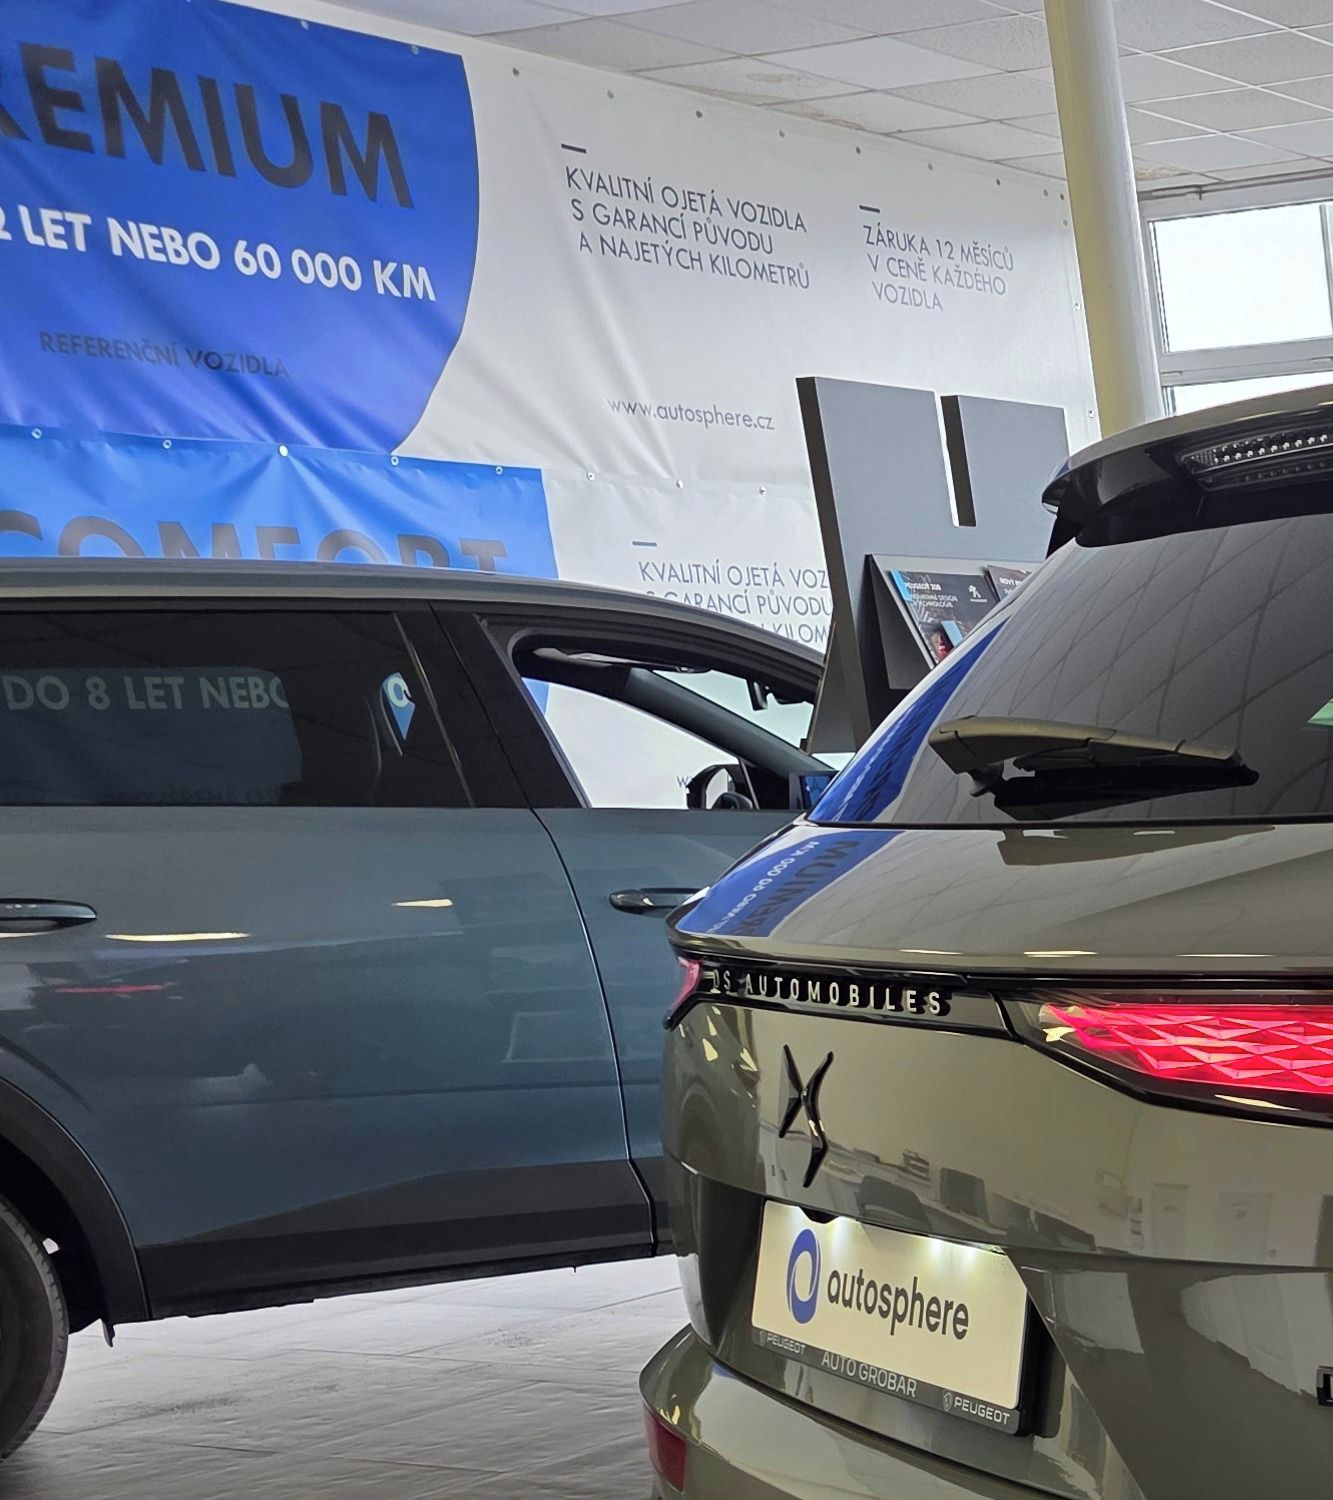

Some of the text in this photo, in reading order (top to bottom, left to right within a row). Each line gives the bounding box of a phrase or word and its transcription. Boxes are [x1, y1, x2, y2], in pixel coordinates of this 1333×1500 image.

[566, 166, 807, 232] KVALITNÍ OJETÁ VOZIDLA
[571, 199, 773, 255] S GARANCÍ PŮVODU
[863, 222, 1014, 272] ZÁRUKA 12 MĚSÍCŮ
[17, 204, 92, 252] LET
[106, 216, 221, 271] NEBO
[233, 239, 282, 280] 60
[291, 248, 363, 292] 000
[372, 259, 436, 302] KM
[579, 232, 810, 290] A NAJETÝCH KILOMETRŮ
[867, 253, 1007, 296] V CENĚ KAŽDÉHO
[872, 281, 944, 311] VOZIDLA
[39, 331, 291, 378] REFERENČNÍ VOZIDLA
[606, 398, 776, 431] www.autosphere.cz
[638, 559, 721, 585] KVALITNÍ
[727, 562, 785, 588] OJETÁ
[1, 674, 70, 712] DO
[85, 676, 110, 711] 8
[123, 676, 185, 711] LET
[745, 973, 940, 1014] AUTOMOBILES
[827, 1268, 969, 1340] autosphere
[767, 1333, 806, 1355] PEUGEOT
[821, 1351, 917, 1398] AUTO GROBAR
[954, 1396, 1010, 1425] PEUGEOT
